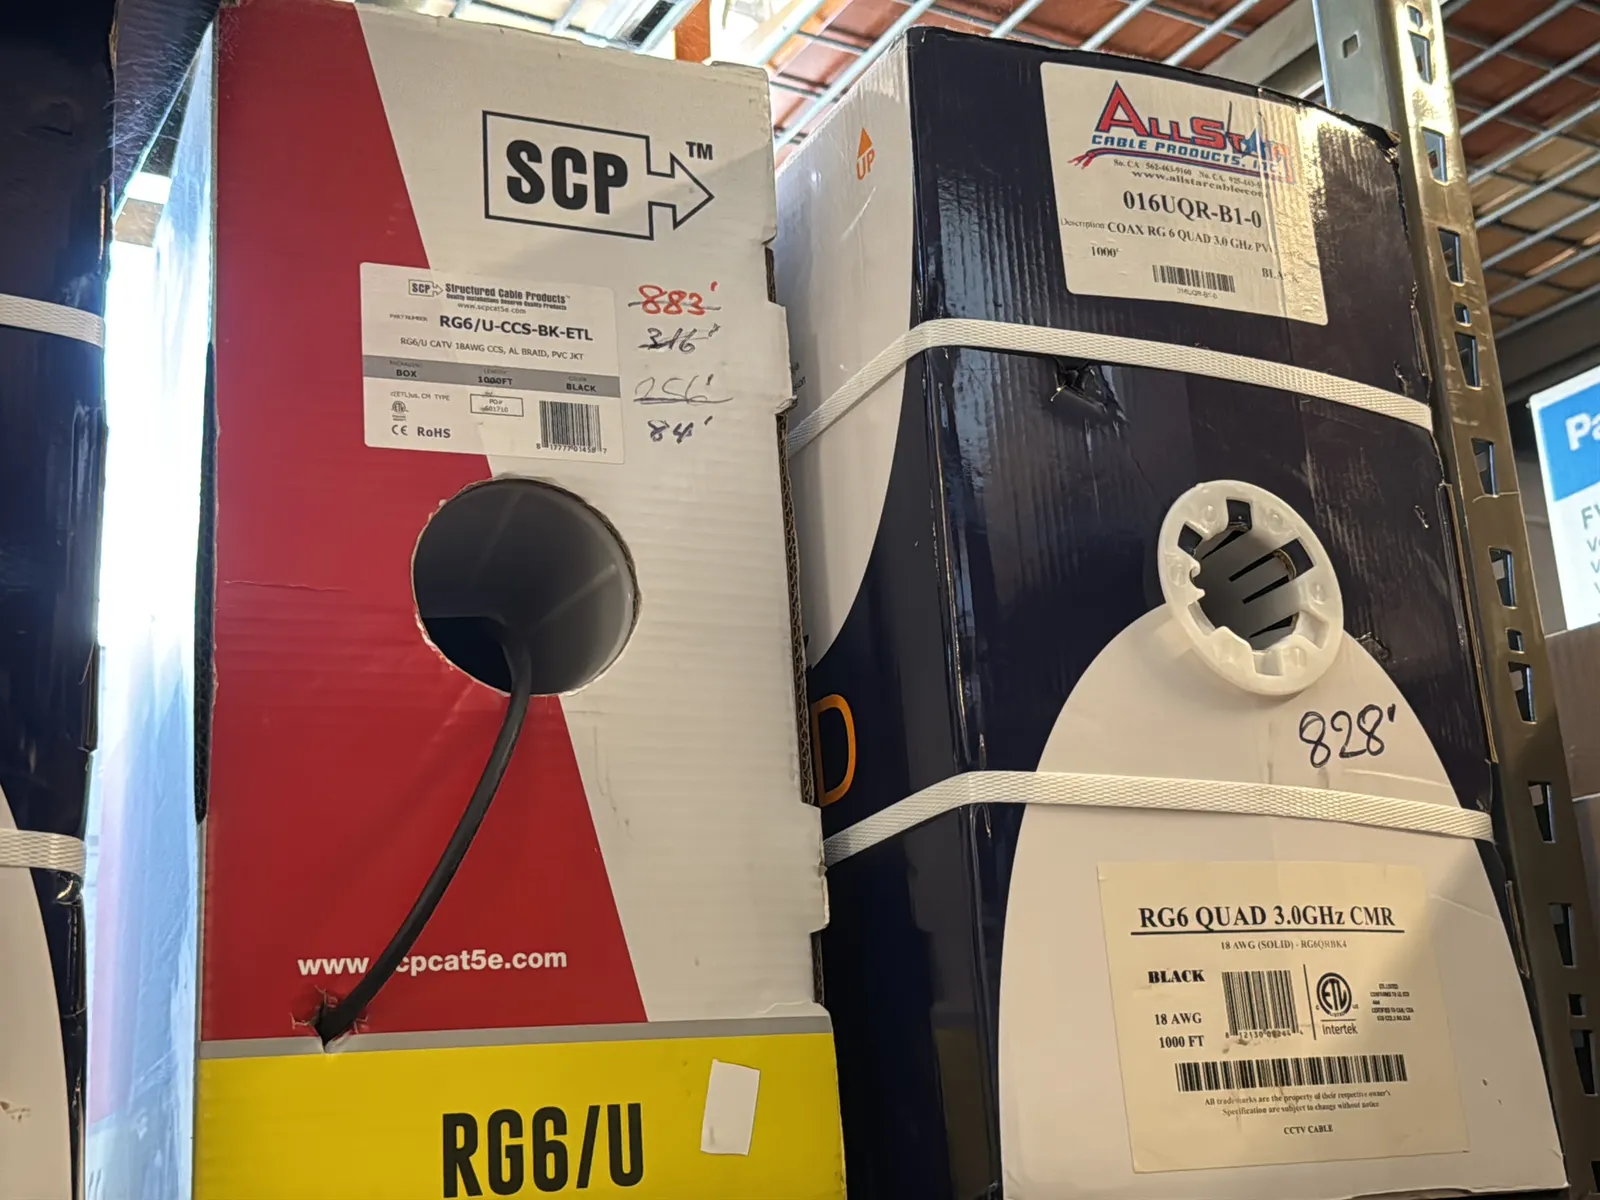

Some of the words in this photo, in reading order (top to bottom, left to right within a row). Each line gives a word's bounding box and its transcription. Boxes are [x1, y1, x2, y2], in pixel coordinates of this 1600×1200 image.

[1092, 135, 1148, 150] CABLE
[856, 149, 875, 181] UP
[506, 139, 628, 215] SCP
[685, 141, 713, 160] TM
[1123, 190, 1262, 229] 016UQR-B1-0
[1108, 222, 1144, 236] COAX
[1148, 225, 1166, 238] RG
[1169, 229, 1175, 239] 6
[1177, 229, 1211, 244] QUAD
[1214, 234, 1228, 246] 3.0
[1230, 238, 1253, 251] GHz
[412, 283, 431, 294] SCP
[445, 283, 495, 297] Structured
[499, 289, 522, 299] Cable
[526, 291, 565, 303] Products
[639, 281, 717, 315] 883'
[439, 315, 593, 341] RG6/U-CCS-BK-ETL
[400, 337, 427, 347] RG6/U
[430, 340, 452, 349] CATV
[455, 342, 485, 352] 18AWG
[487, 345, 506, 355] CCS,
[521, 349, 549, 358] BRAID,
[552, 351, 568, 359] PVC
[569, 352, 584, 360] JKT
[396, 369, 417, 378] BOX
[566, 383, 596, 392] BLACK
[417, 427, 451, 438] RoHS
[1299, 703, 1396, 768] 828'
[1138, 906, 1189, 928] RG6
[1196, 906, 1266, 931] QUAD
[1274, 905, 1345, 926] 3.0GHz
[1350, 906, 1396, 926] CMR
[1221, 941, 1230, 950] 18
[1233, 940, 1255, 949] AWG
[1258, 940, 1293, 949] (SOLID)
[1148, 970, 1205, 984] BLACK
[1155, 1014, 1168, 1025] 18
[1171, 1013, 1202, 1024] AWG
[1322, 1023, 1358, 1035] Intertek
[1159, 1037, 1185, 1048] 1000
[1189, 1035, 1204, 1047] FT
[1284, 1126, 1305, 1135] CCTV
[1308, 1124, 1333, 1133] CABLE
[443, 1103, 644, 1198] RG6/U
